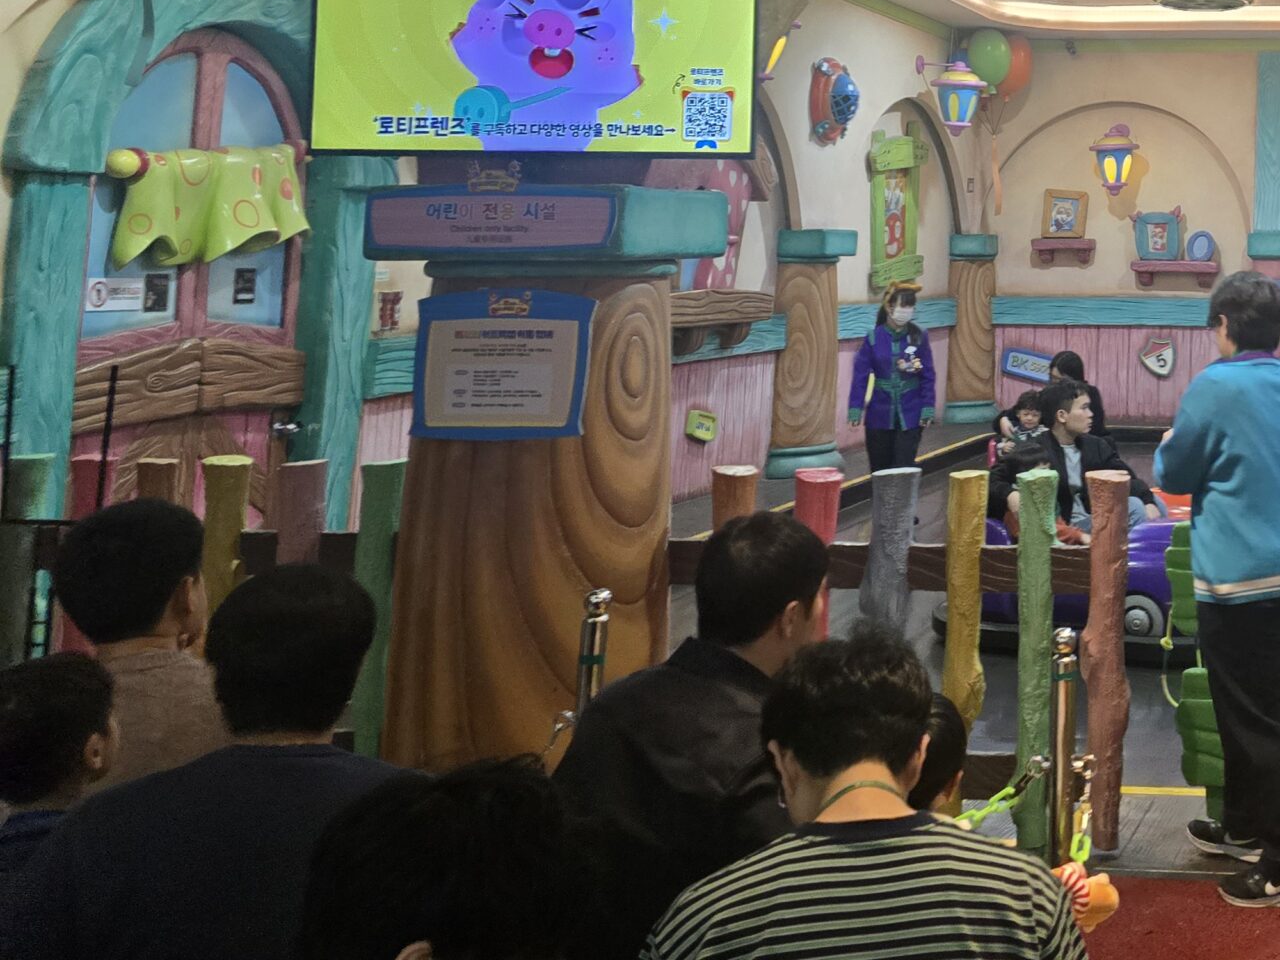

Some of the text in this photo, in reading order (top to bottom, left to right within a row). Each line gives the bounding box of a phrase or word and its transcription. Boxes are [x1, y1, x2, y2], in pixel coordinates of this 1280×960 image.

[483, 122, 527, 136] 구독하고
[530, 123, 567, 137] 다양한
[569, 122, 603, 137] 영상을
[607, 123, 665, 136] 만나보세요
[426, 202, 557, 221] 어린이 전용 시설
[1154, 353, 1168, 369] 5
